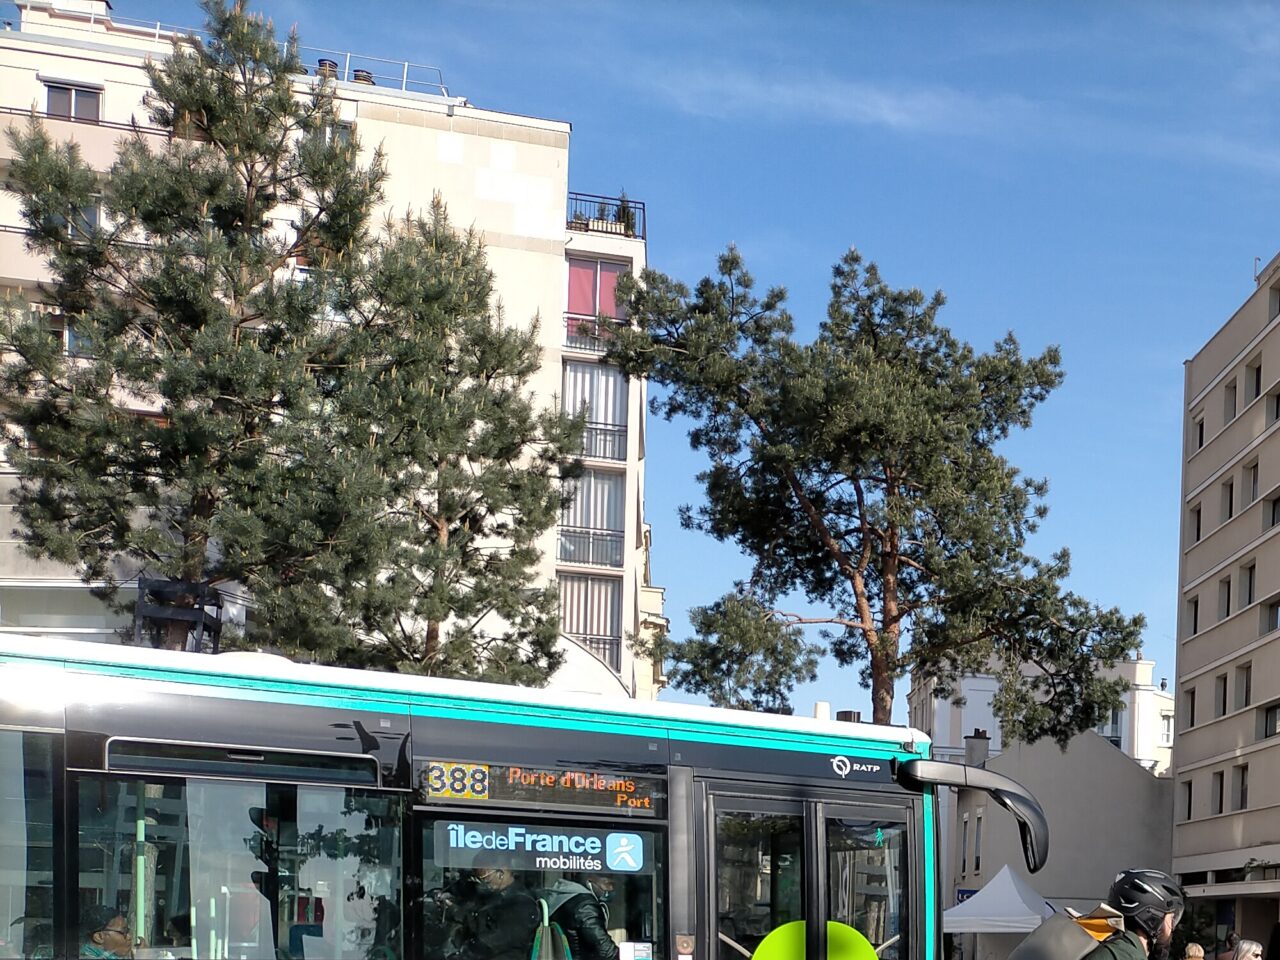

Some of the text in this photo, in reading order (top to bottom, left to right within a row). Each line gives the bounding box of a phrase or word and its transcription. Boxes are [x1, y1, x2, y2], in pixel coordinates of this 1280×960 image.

[853, 763, 880, 773] RATP
[429, 763, 636, 796] 388 Porte d'Orléans
[617, 794, 650, 809] Port
[536, 855, 602, 871] mobilités
